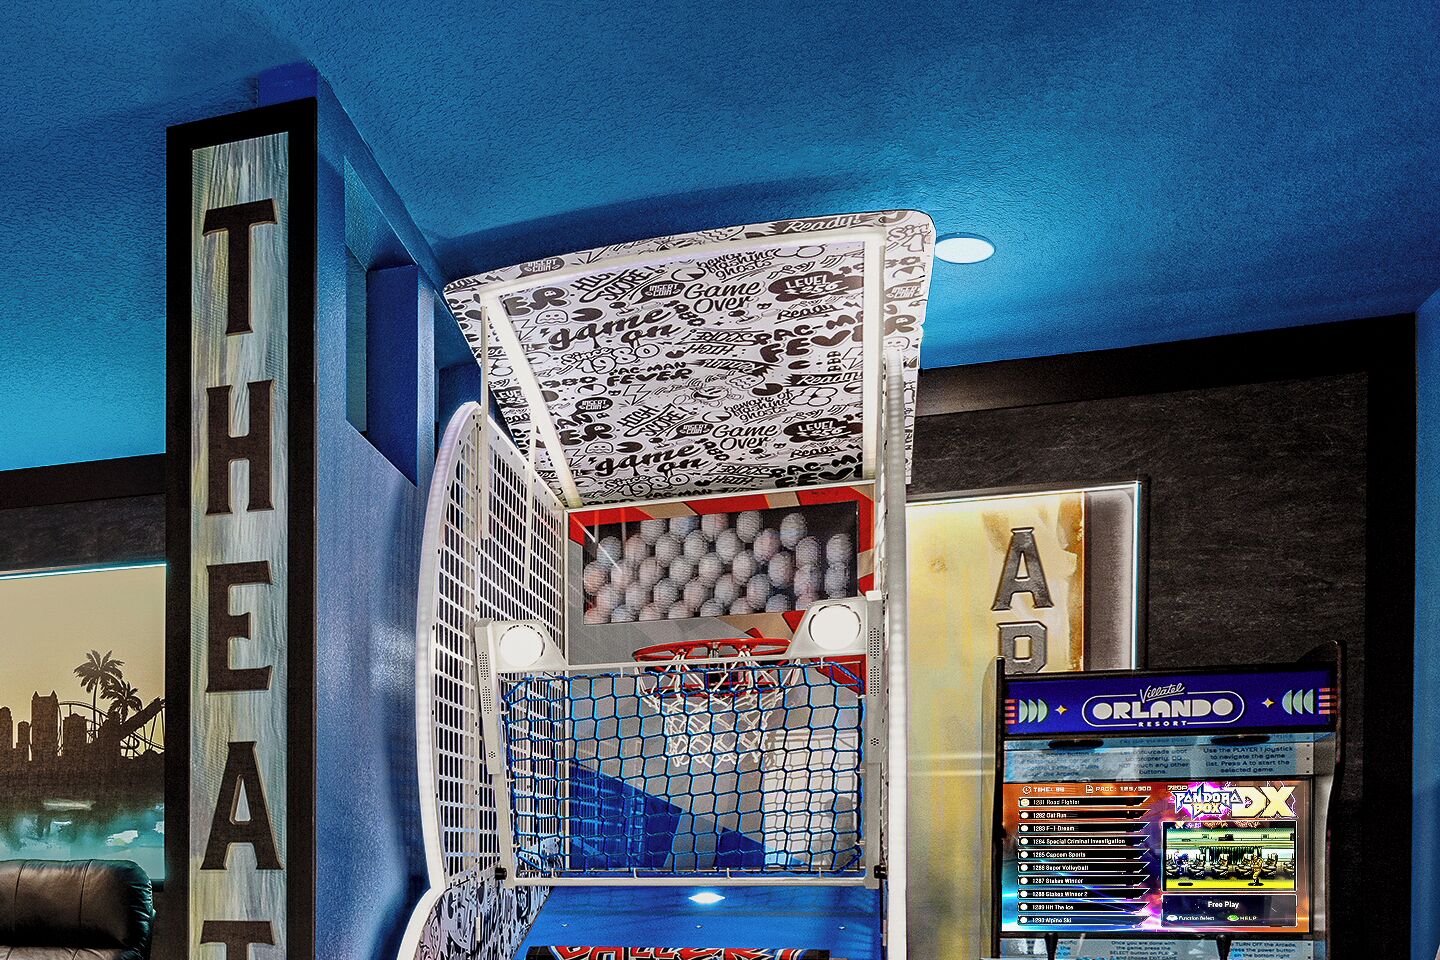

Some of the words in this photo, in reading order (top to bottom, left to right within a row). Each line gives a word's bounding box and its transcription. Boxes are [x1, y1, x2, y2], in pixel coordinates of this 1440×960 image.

[716, 259, 773, 280] ghosts
[684, 280, 761, 300] Game
[785, 274, 829, 289] LEVEL
[694, 296, 754, 314] Over
[776, 303, 836, 320] Ready
[549, 309, 670, 350] game
[621, 324, 681, 347] on
[561, 347, 613, 364] Since
[577, 344, 659, 374] 1980
[607, 368, 693, 387] FEVER
[617, 405, 661, 428] HIGH
[740, 406, 788, 422] ghosts
[712, 424, 779, 439] Game
[797, 420, 835, 432] LEVEL
[720, 436, 770, 451] Over
[595, 445, 701, 477] game
[657, 458, 709, 477] on
[604, 475, 649, 490] Since
[618, 474, 690, 497] 1980
[1139, 683, 1186, 704] Villatel
[1092, 698, 1234, 721] ORLANDO
[1138, 720, 1188, 728] RESORT
[1172, 784, 1243, 814] PANDORA
[1226, 786, 1297, 817] DX
[1191, 803, 1221, 819] BOX
[1225, 901, 1240, 909] Play
